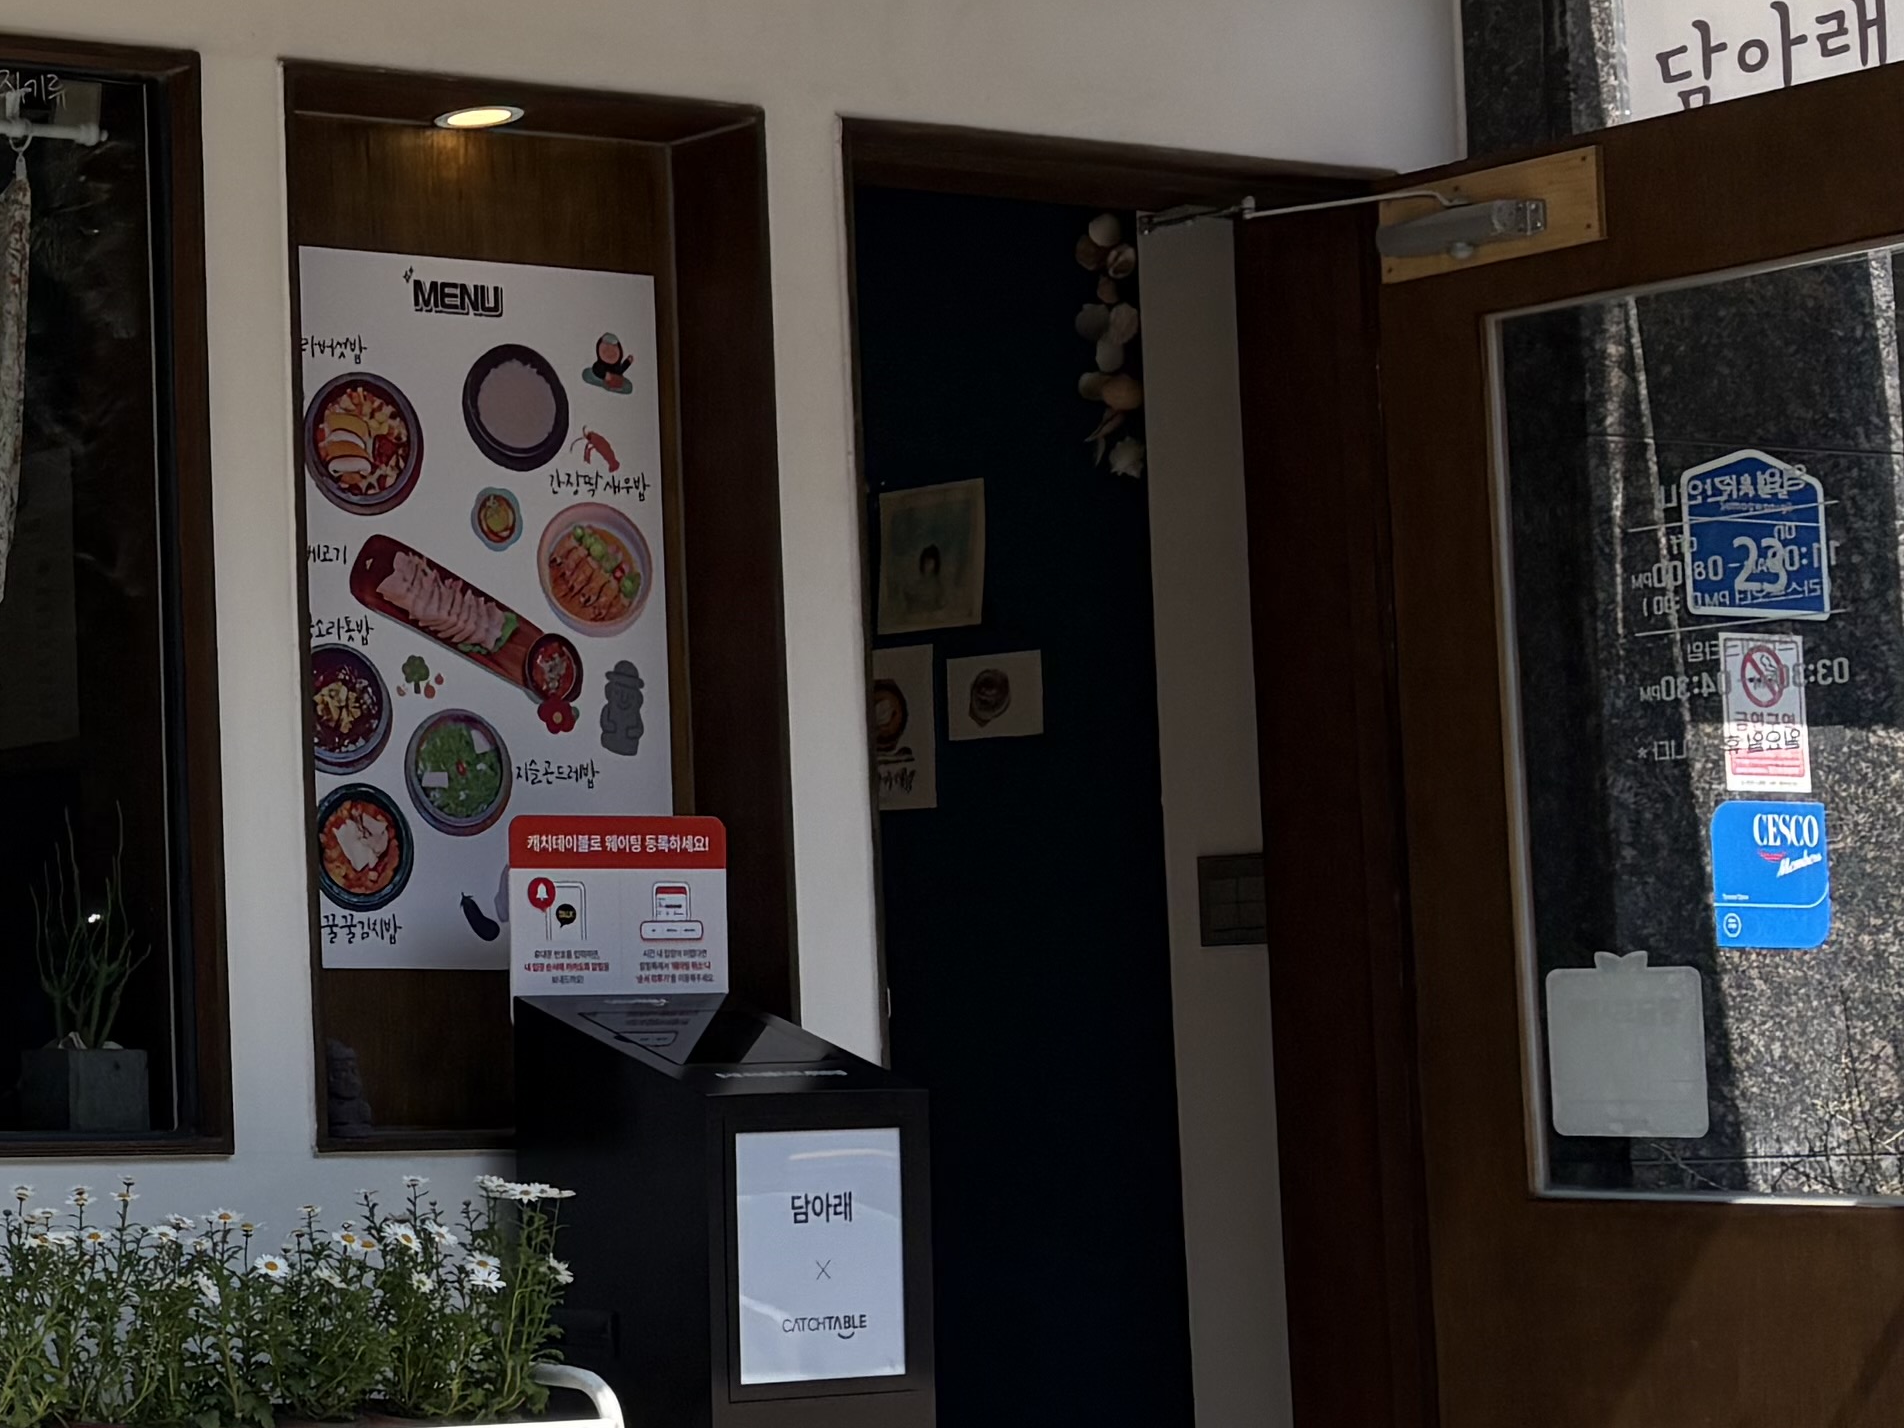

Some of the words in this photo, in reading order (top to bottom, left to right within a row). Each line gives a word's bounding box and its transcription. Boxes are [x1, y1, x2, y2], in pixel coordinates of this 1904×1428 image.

[412, 279, 504, 318] MENU
[1732, 536, 1789, 594] 23
[310, 616, 375, 646] 소라톳밥
[527, 833, 603, 854] 캐치테이블로
[605, 833, 642, 854] 웨이팅
[645, 834, 710, 854] 등록하세요!
[1752, 812, 1820, 848] CESCO
[790, 1190, 854, 1224] 담아래
[782, 1314, 868, 1335] CATCHTABLE
